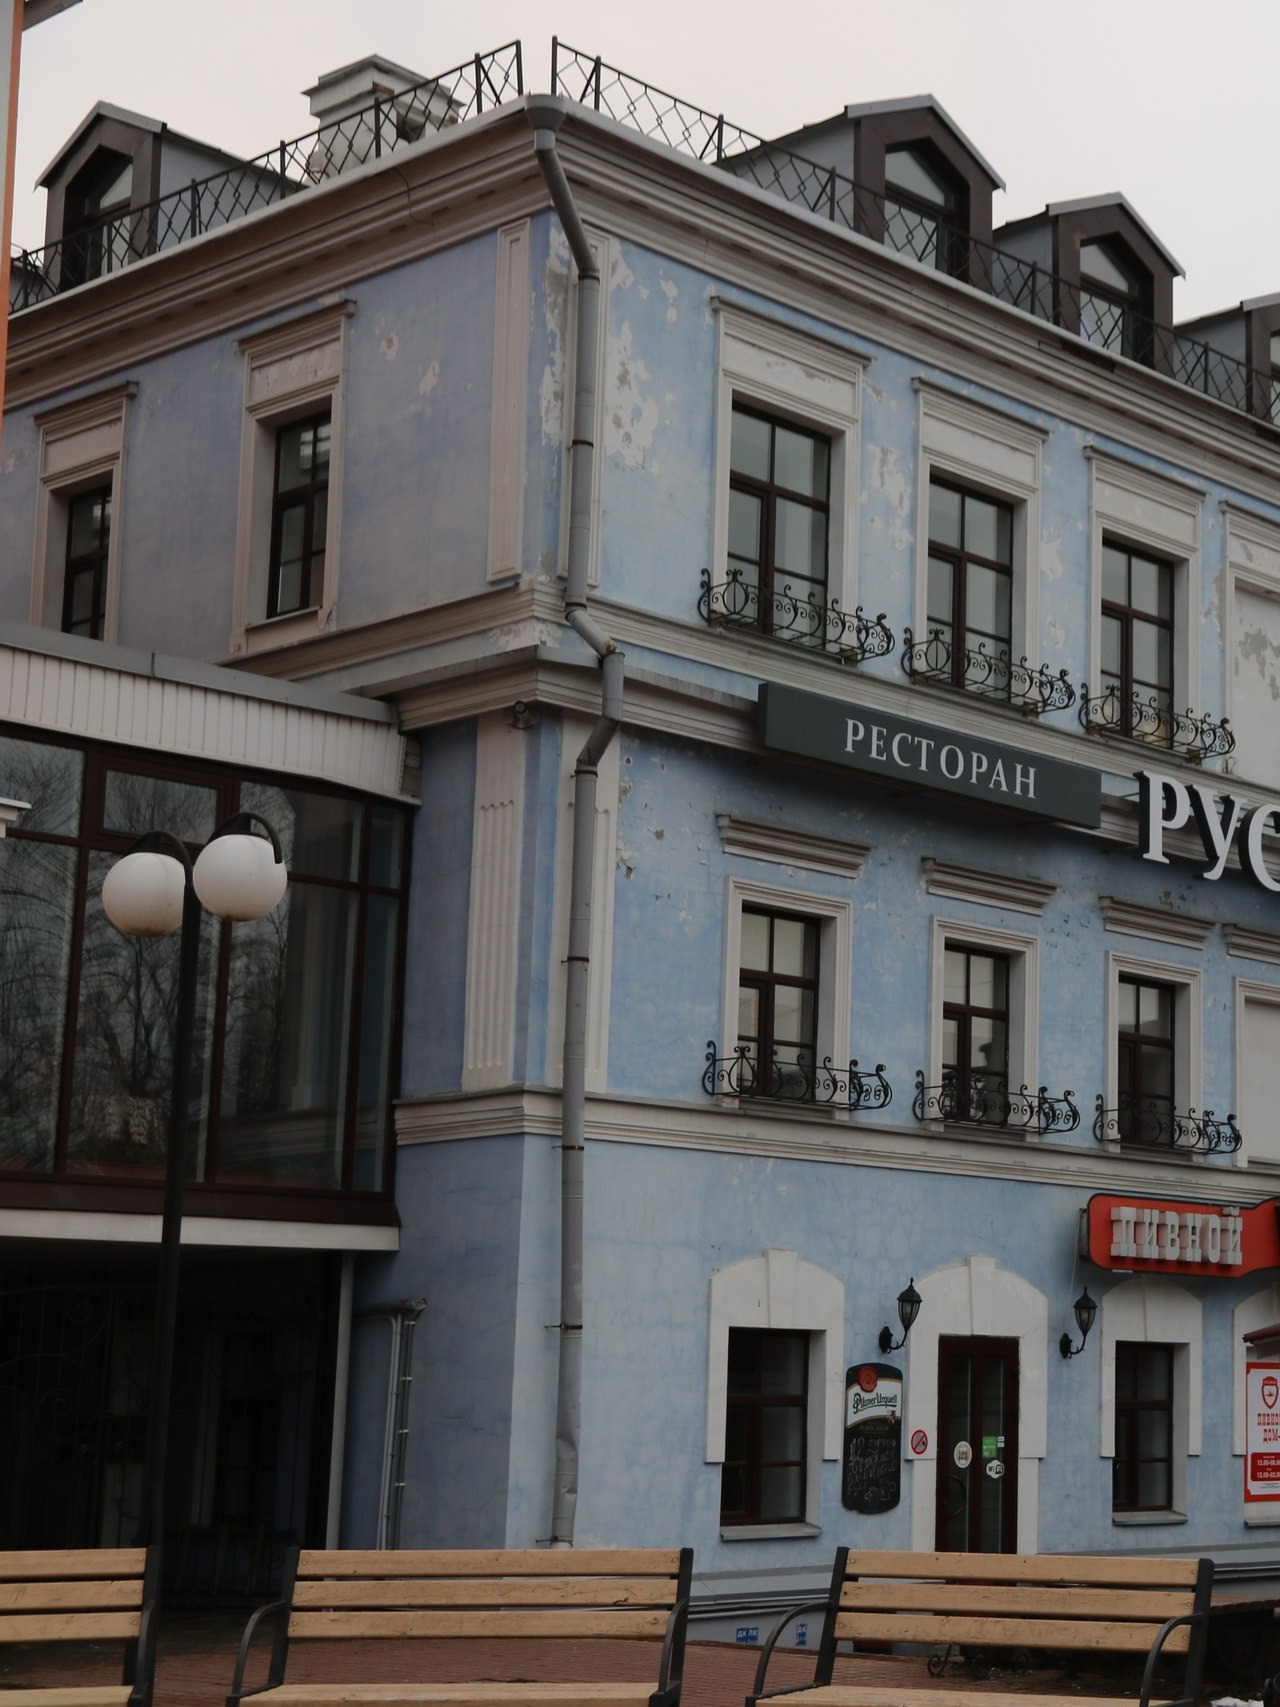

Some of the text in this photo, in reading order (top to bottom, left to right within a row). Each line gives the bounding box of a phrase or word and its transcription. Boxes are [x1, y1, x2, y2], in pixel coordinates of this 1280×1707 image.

[843, 717, 1037, 799] РЕСТОРАН
[1110, 1206, 1244, 1266] ПИВНОЙ
[853, 1392, 897, 1414] Pilsner Urquell
[1263, 1429, 1279, 1443] ДОМ
